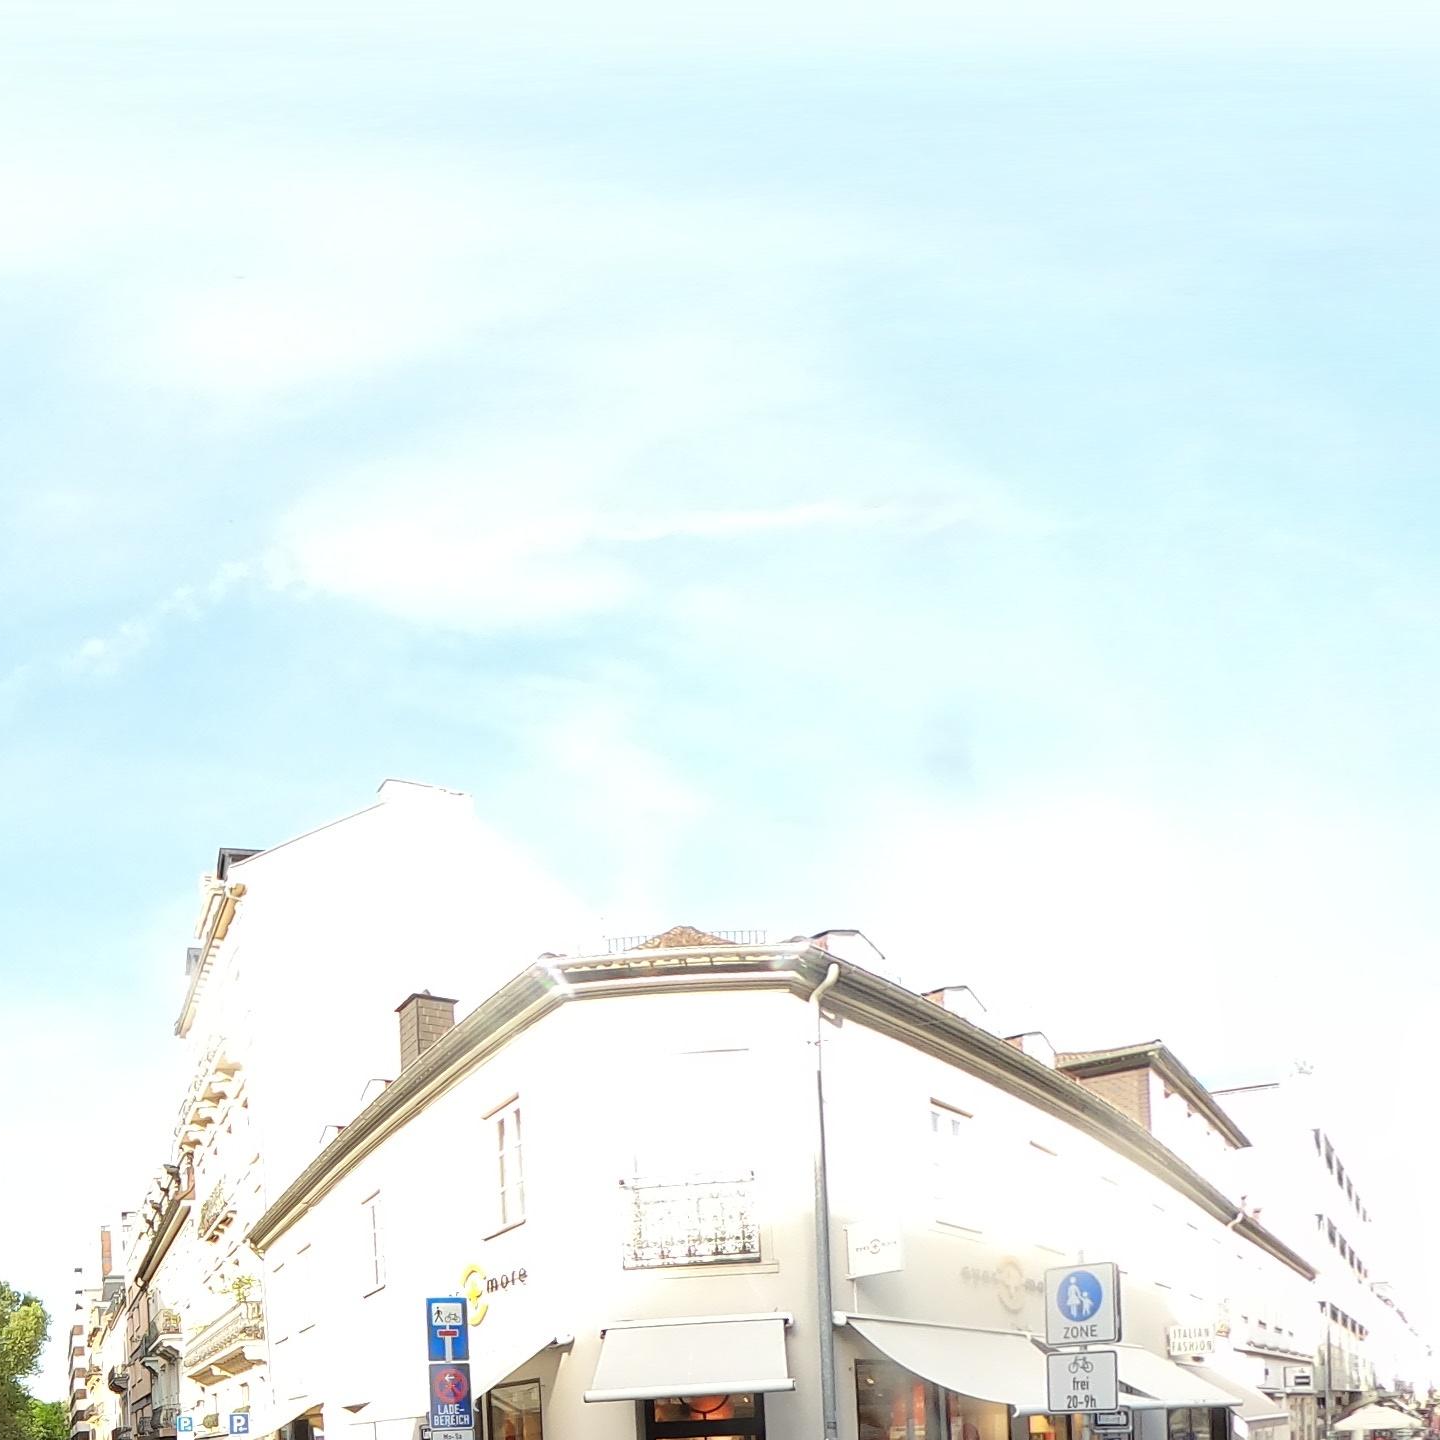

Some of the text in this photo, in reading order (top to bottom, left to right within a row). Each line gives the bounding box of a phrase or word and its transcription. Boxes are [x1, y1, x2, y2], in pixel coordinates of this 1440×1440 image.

[486, 1267, 528, 1294] more
[1063, 1324, 1098, 1339] ZONE
[1072, 1377, 1089, 1391] frei
[1066, 1395, 1097, 1408] 20-9h
[437, 1404, 465, 1415] LADE-
[433, 1414, 470, 1426] BEREICH
